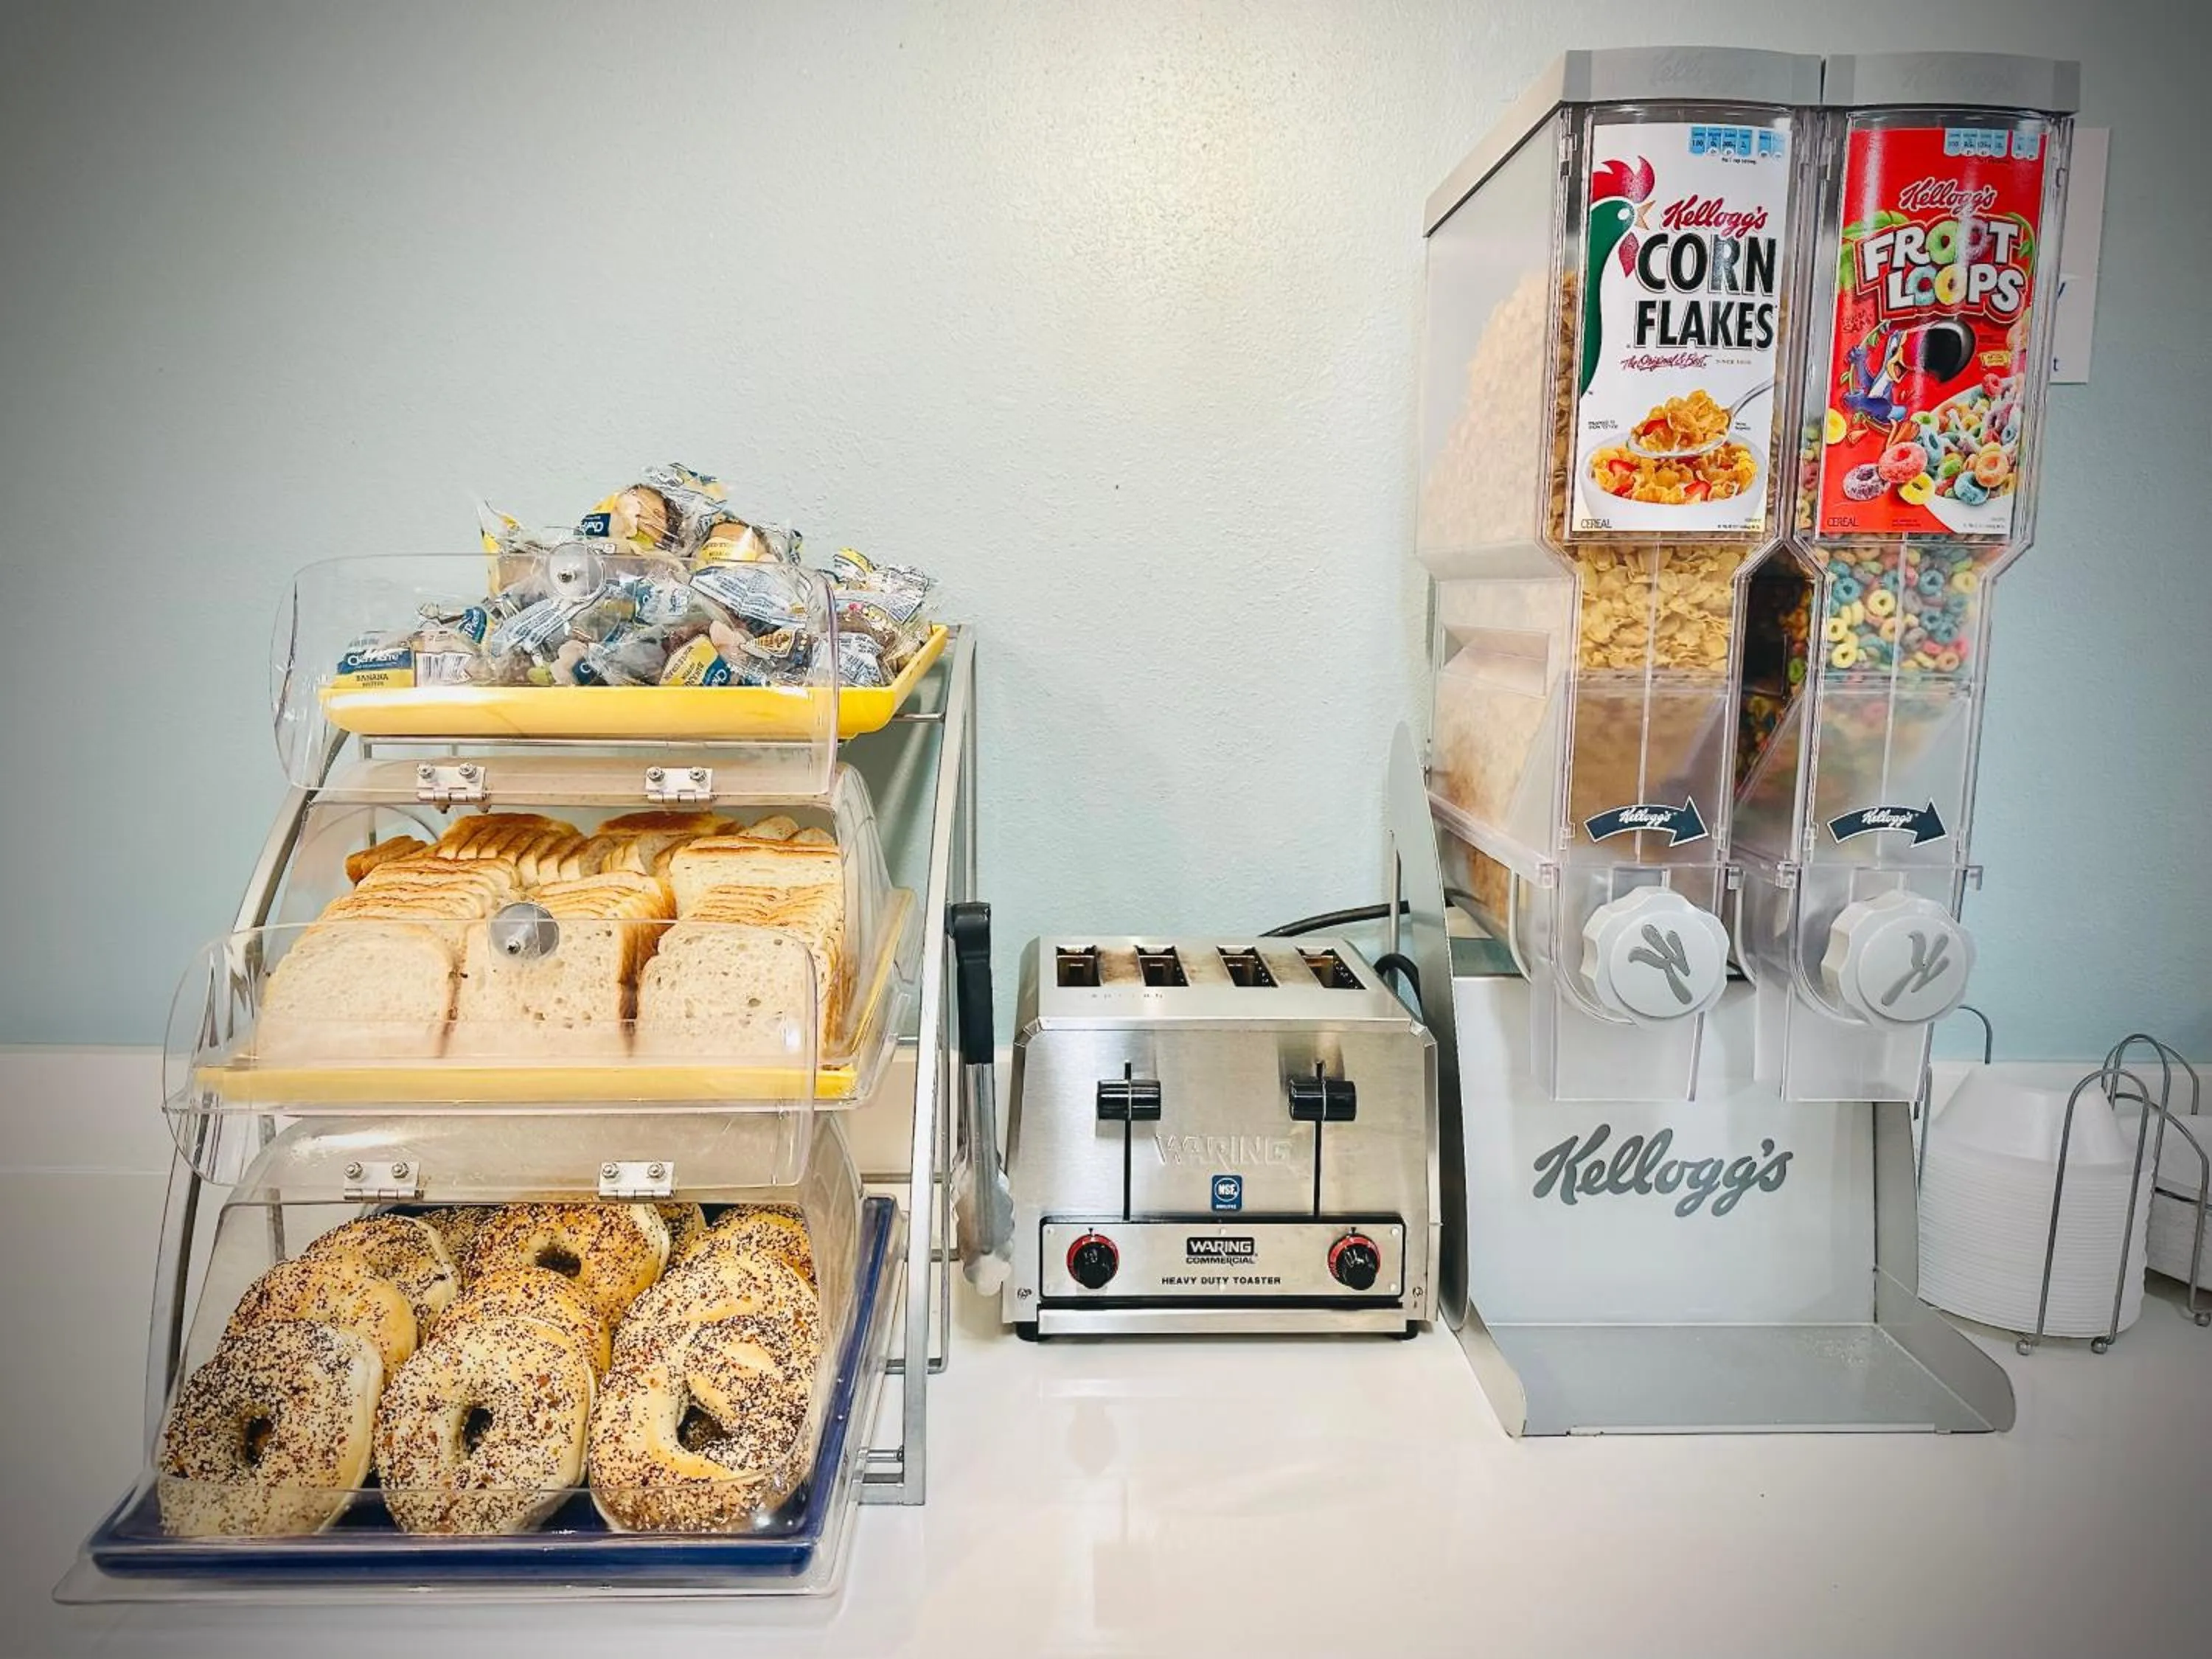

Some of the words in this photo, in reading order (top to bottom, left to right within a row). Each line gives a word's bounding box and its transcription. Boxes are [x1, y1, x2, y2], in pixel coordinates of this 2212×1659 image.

[1901, 177, 1997, 215] Kellogg's
[1662, 194, 1768, 238] Kellogg's
[1637, 232, 1776, 293] CORN
[1862, 220, 2019, 282] FROOT
[1888, 263, 2025, 313] LOOPS
[1635, 300, 1774, 349] FLAKES
[1580, 518, 1613, 529] CEREAL
[1827, 517, 1860, 527] CEREAL
[1618, 807, 1672, 827] Kellogg's
[1862, 807, 1913, 827] Kellogg's
[1533, 1124, 1794, 1217] Kellogg's
[1185, 1256, 1256, 1266] COMMERCIAL
[1189, 1241, 1252, 1256] WARING
[1161, 1276, 1197, 1285] HEAVY
[1200, 1276, 1229, 1285] DUTY
[1233, 1276, 1281, 1285] TOASTER
